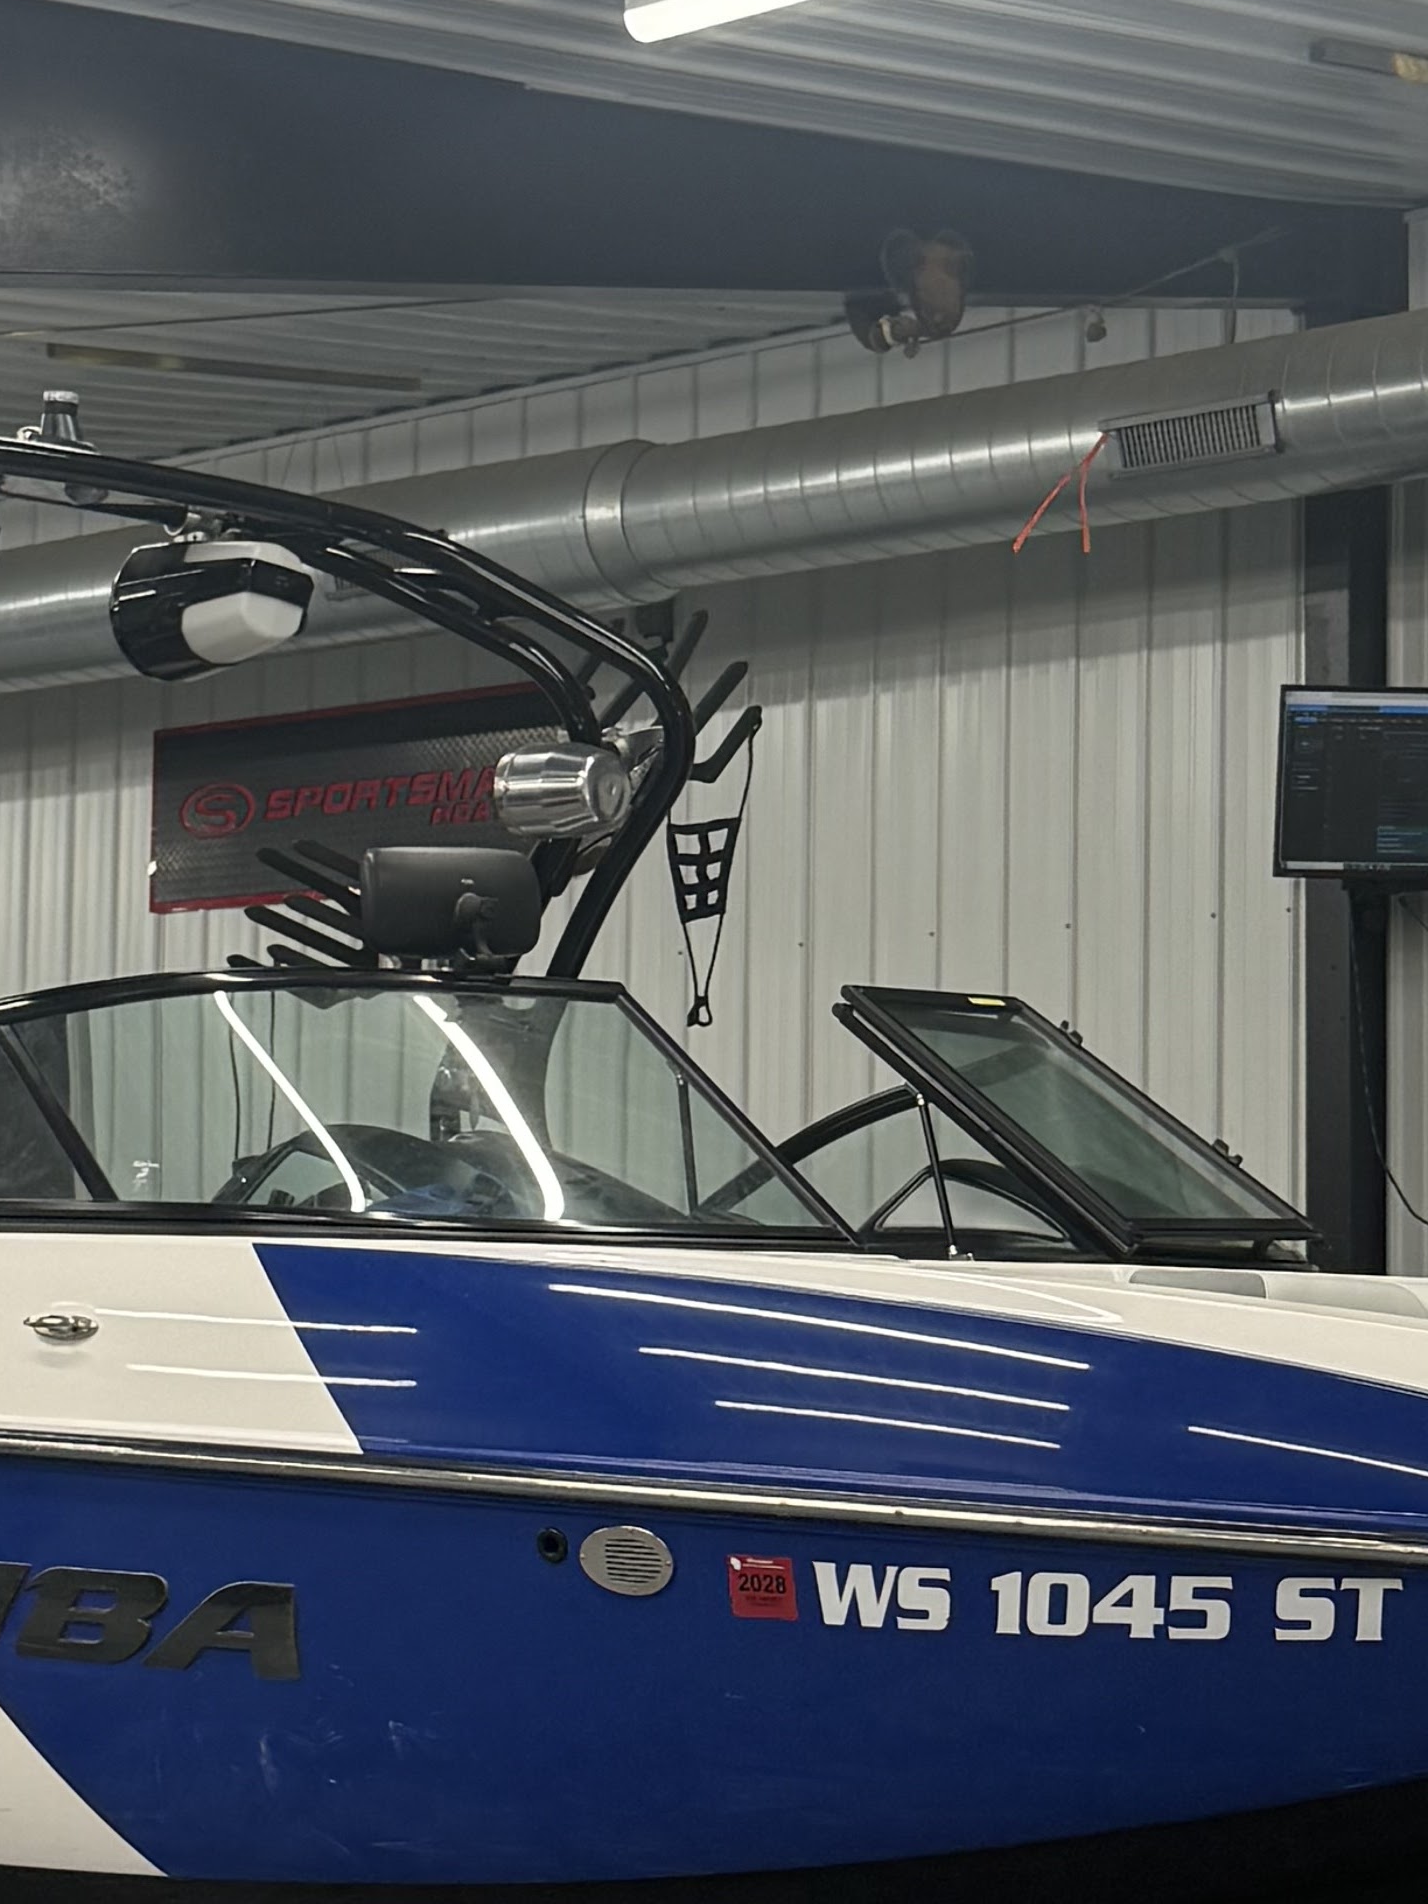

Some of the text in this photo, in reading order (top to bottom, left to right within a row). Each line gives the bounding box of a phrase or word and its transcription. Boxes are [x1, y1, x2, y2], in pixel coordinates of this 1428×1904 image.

[263, 764, 496, 823] SPORTSMA
[738, 1573, 787, 1595] 2028
[812, 1560, 1404, 1642] WS 1045 ST
